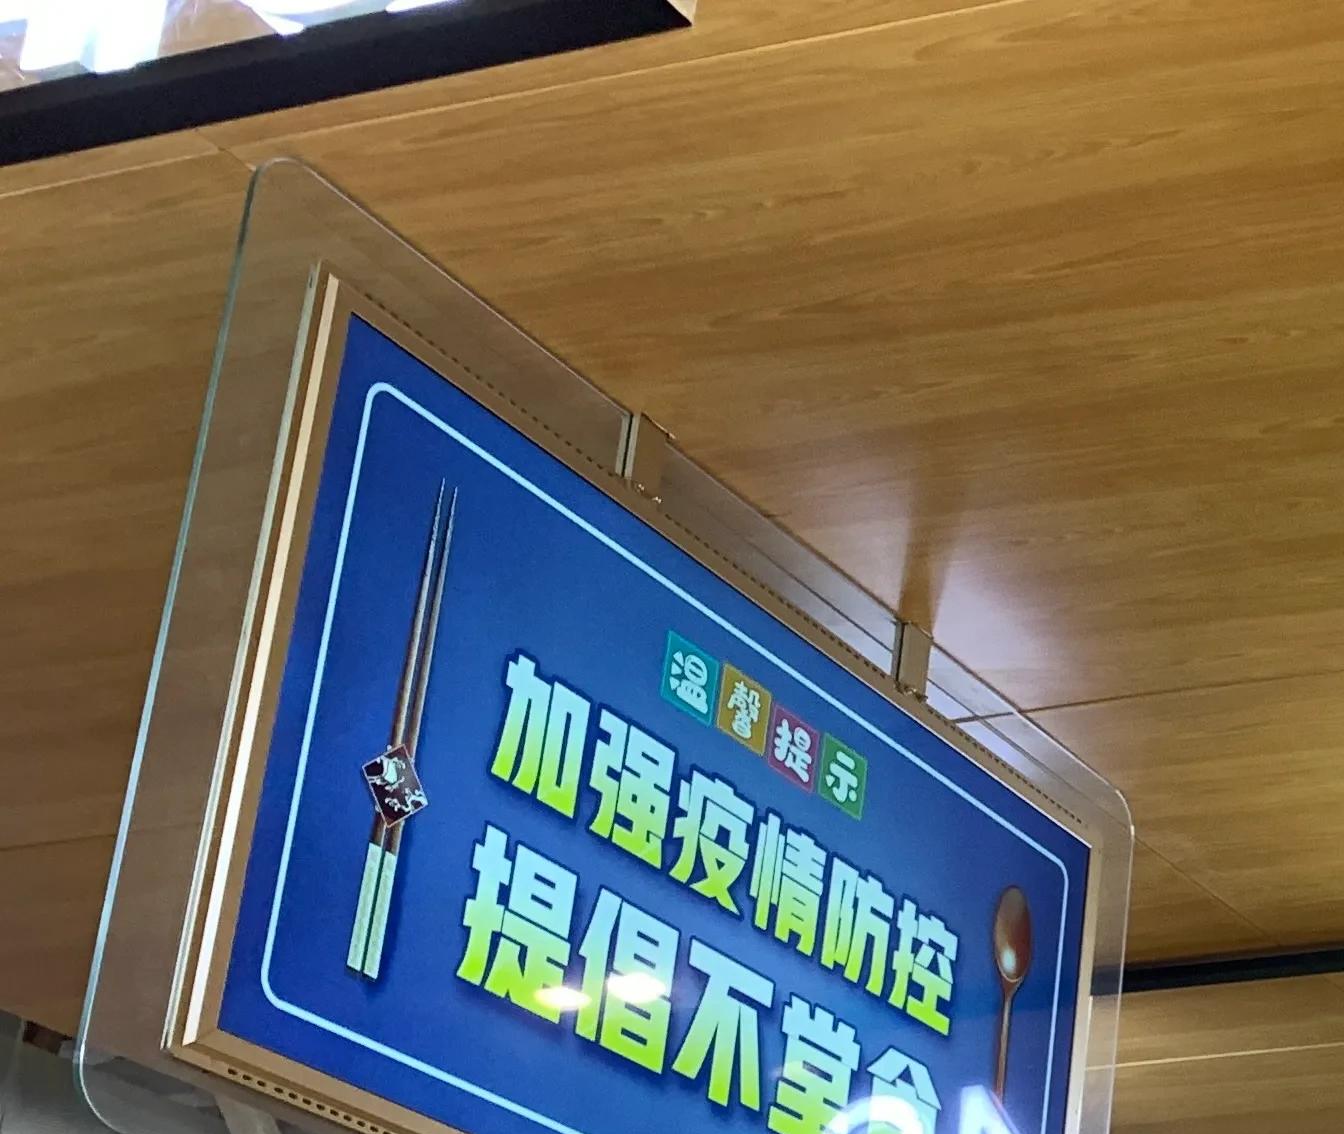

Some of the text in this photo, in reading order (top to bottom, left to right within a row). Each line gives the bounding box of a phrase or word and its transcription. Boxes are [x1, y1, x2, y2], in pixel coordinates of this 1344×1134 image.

[491, 654, 959, 1037] 加强疫情防控
[671, 648, 858, 804] 温馨提示
